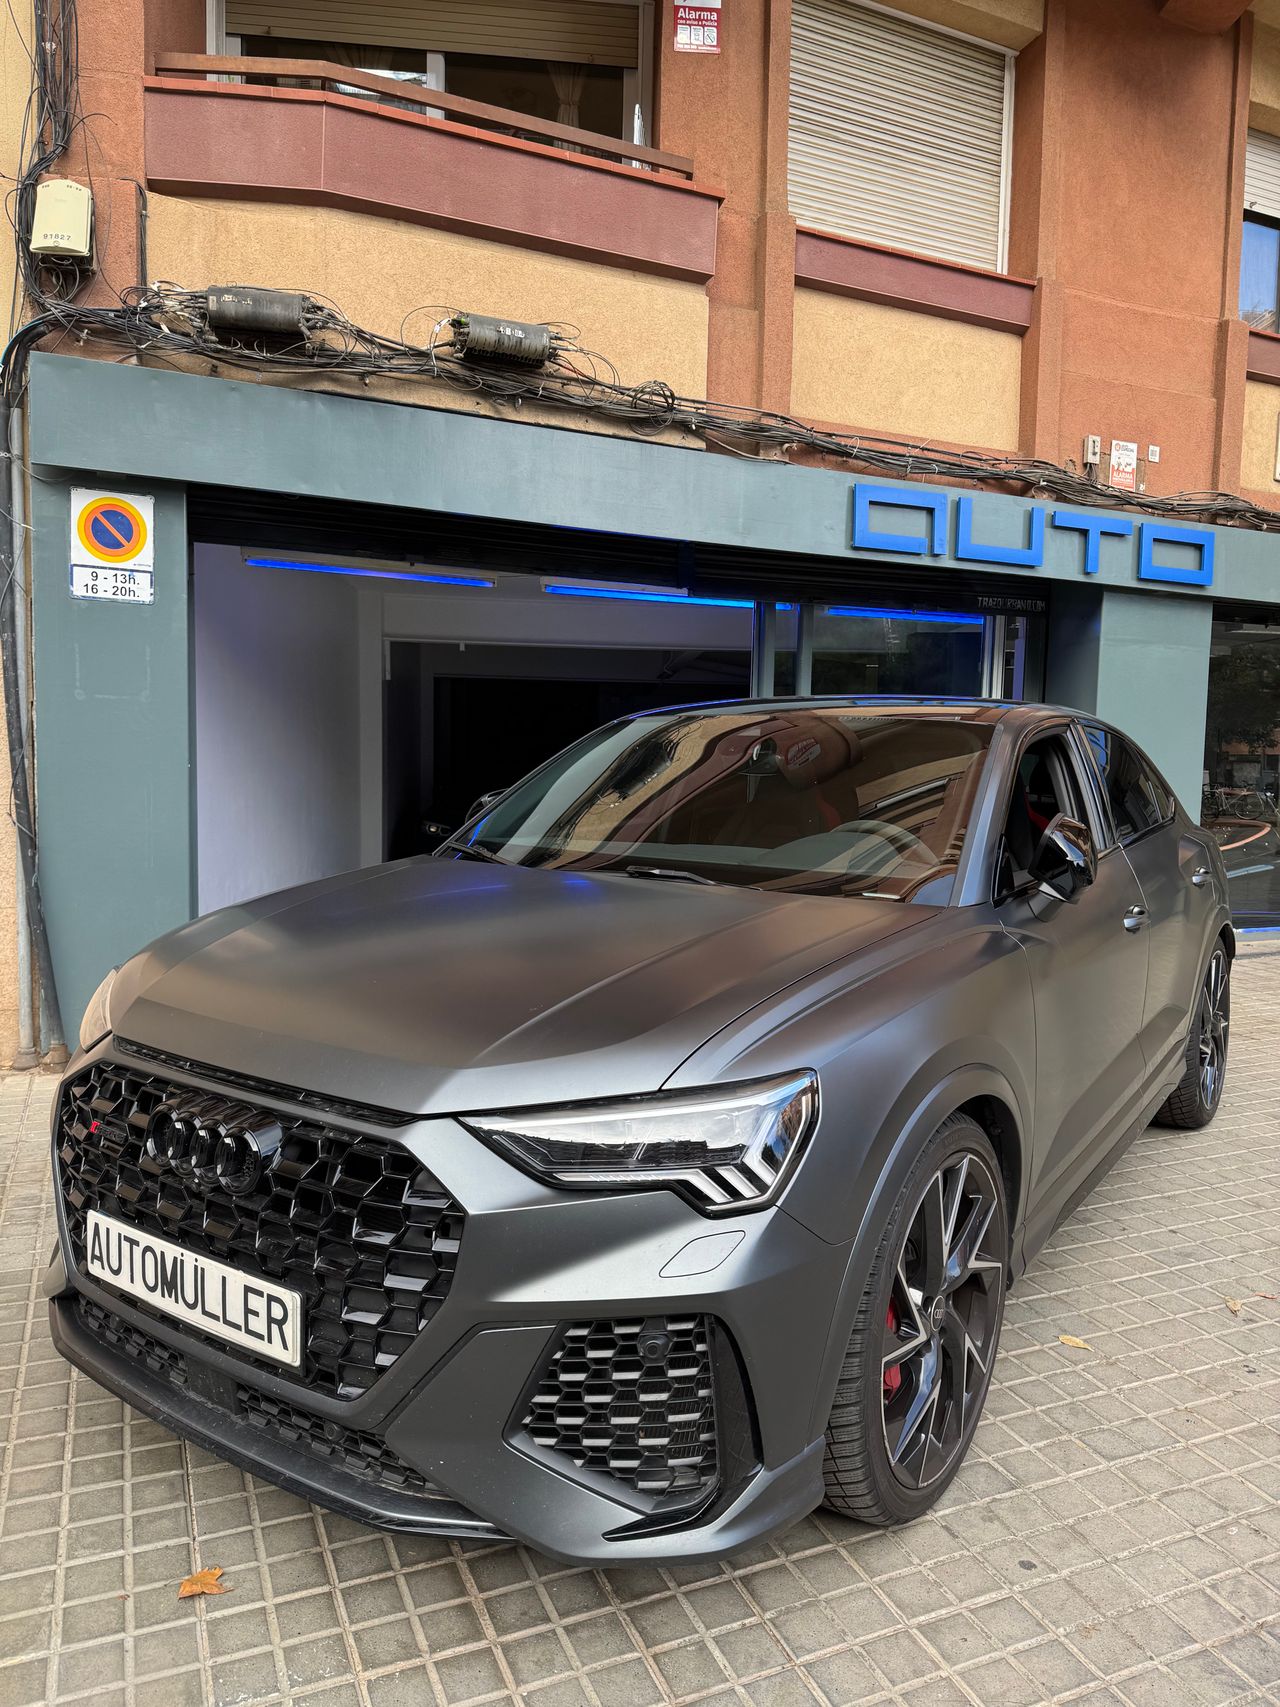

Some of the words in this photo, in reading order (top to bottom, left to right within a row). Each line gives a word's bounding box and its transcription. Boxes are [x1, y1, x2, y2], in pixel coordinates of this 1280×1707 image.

[677, 7, 717, 20] Alarma
[91, 571, 98, 581] 9
[83, 583, 99, 595] 16
[112, 585, 140, 598] 20h.
[90, 1222, 289, 1351] AUTOMÜLLER
